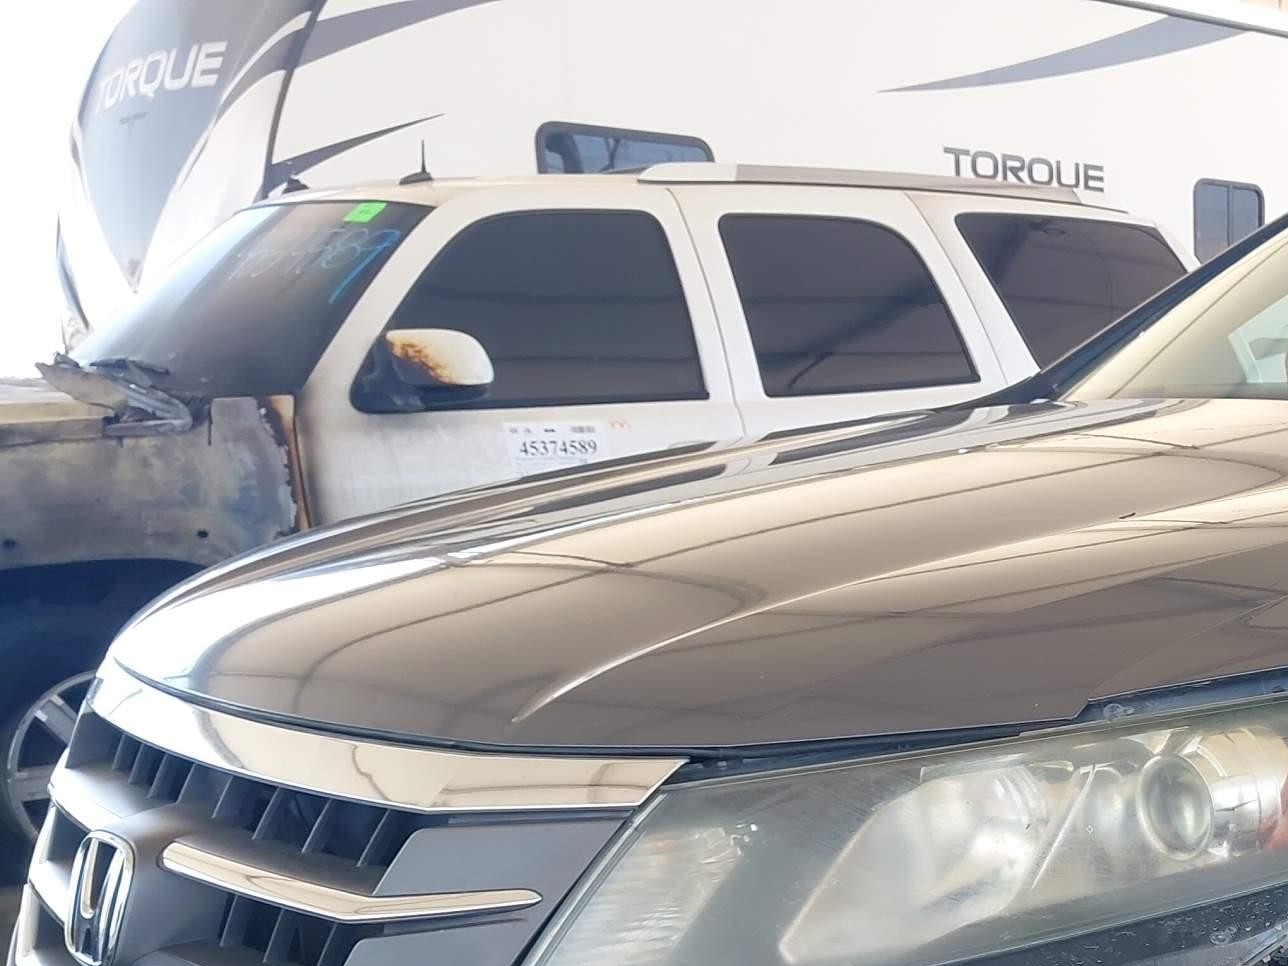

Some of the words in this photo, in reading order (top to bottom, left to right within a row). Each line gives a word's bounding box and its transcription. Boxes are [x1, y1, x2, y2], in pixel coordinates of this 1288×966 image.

[96, 41, 228, 115] TORQUE
[943, 146, 1104, 193] TORQUE
[519, 439, 598, 456] 45374589
